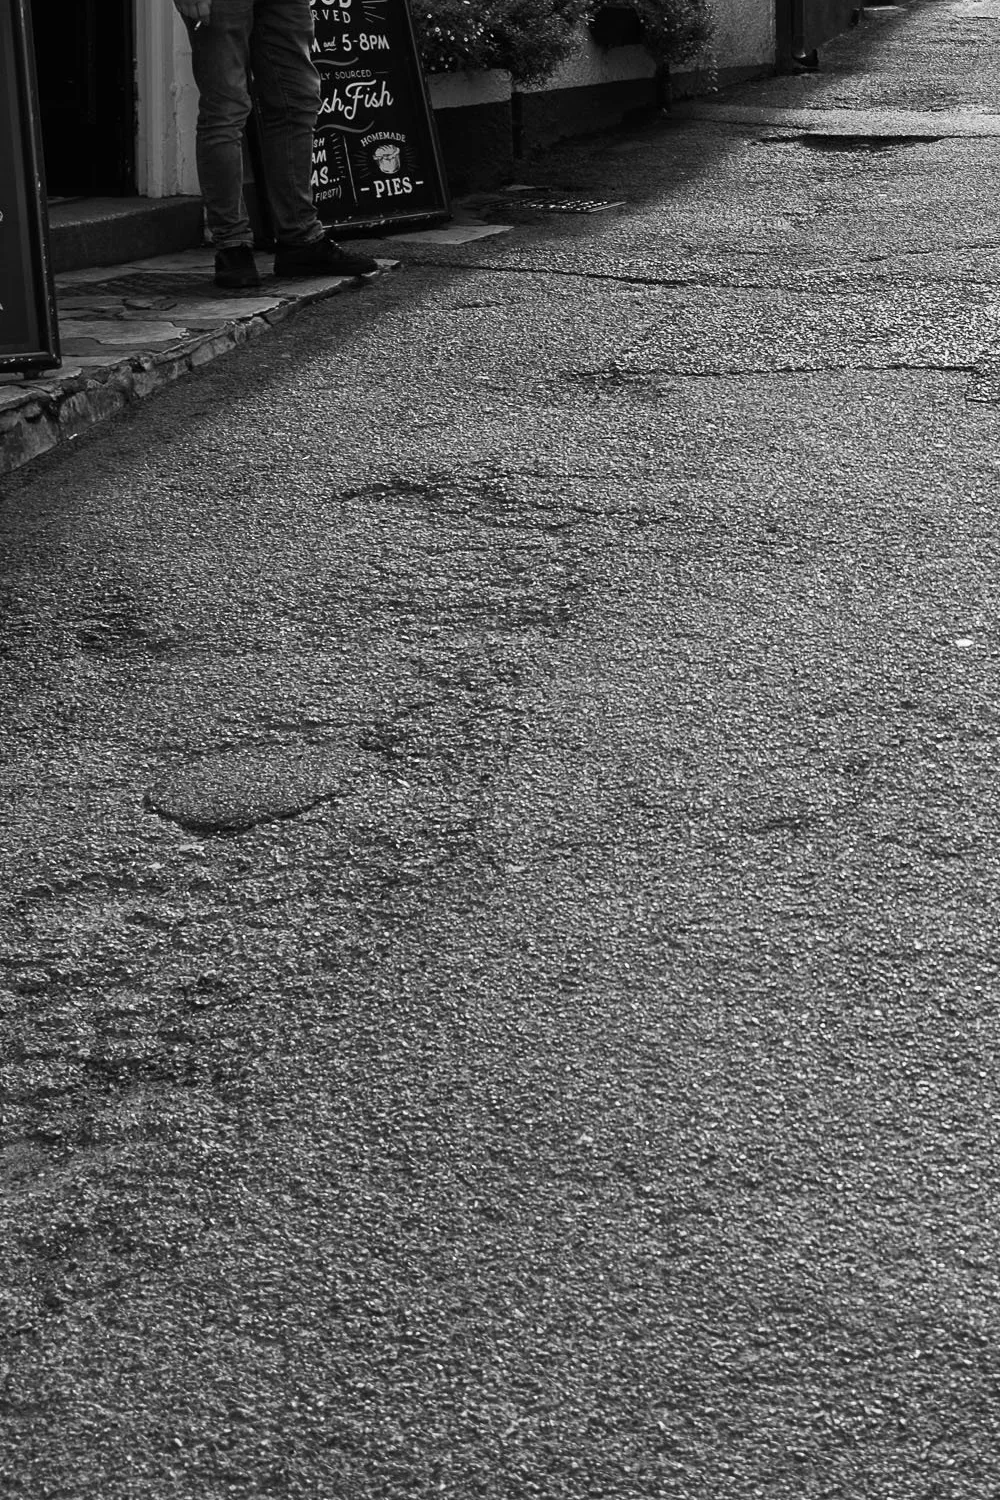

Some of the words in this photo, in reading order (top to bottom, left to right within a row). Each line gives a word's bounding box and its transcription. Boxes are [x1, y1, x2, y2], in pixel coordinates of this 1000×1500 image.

[342, 33, 390, 52] 5-8PM
[335, 69, 372, 80] SOURCED
[344, 79, 394, 120] Fish
[360, 131, 407, 147] HOMEMADE
